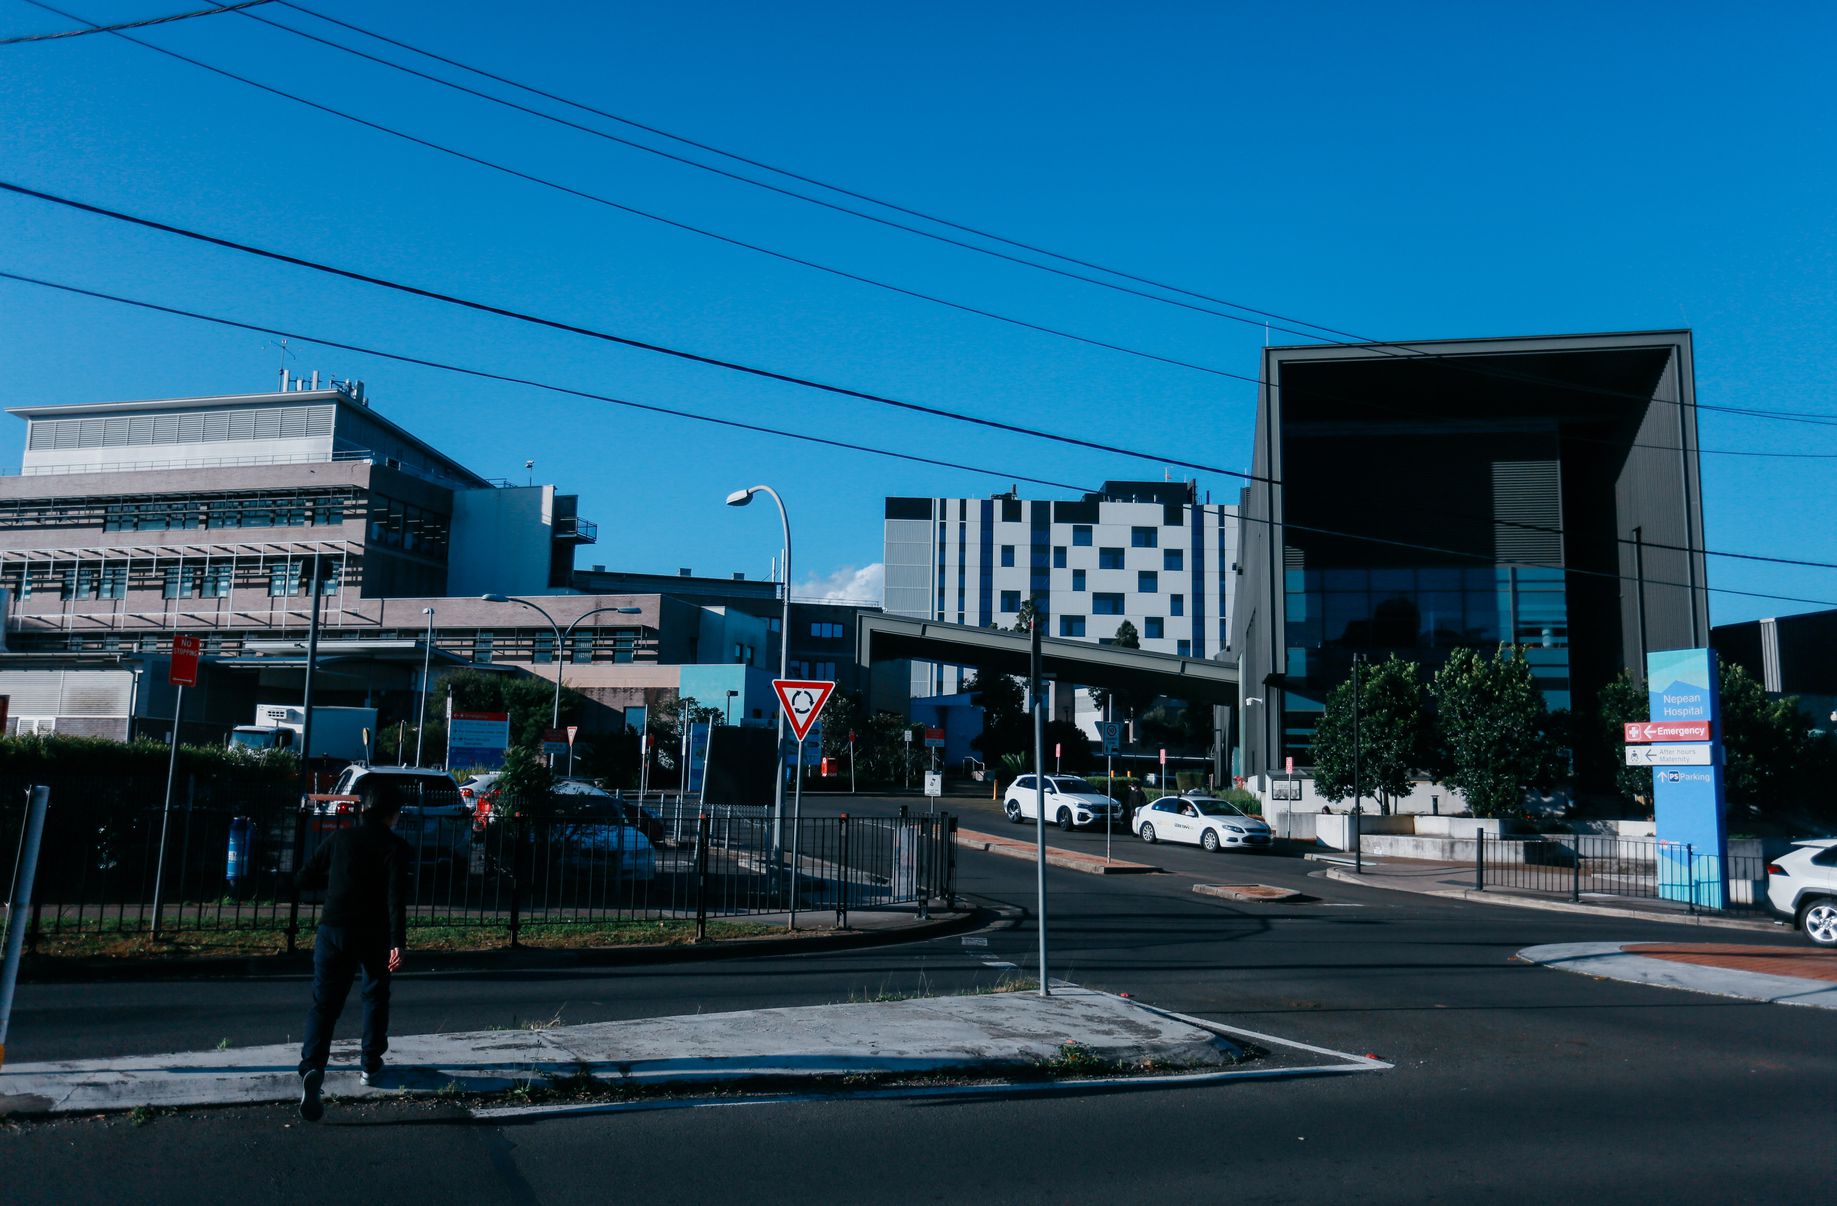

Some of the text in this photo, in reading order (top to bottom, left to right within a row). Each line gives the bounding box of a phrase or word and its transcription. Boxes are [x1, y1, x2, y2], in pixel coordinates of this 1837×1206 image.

[1663, 695, 1701, 705] Nepean
[1664, 707, 1703, 717] Hospital
[1657, 727, 1704, 736] Emergency
[1680, 773, 1710, 782] Parking
